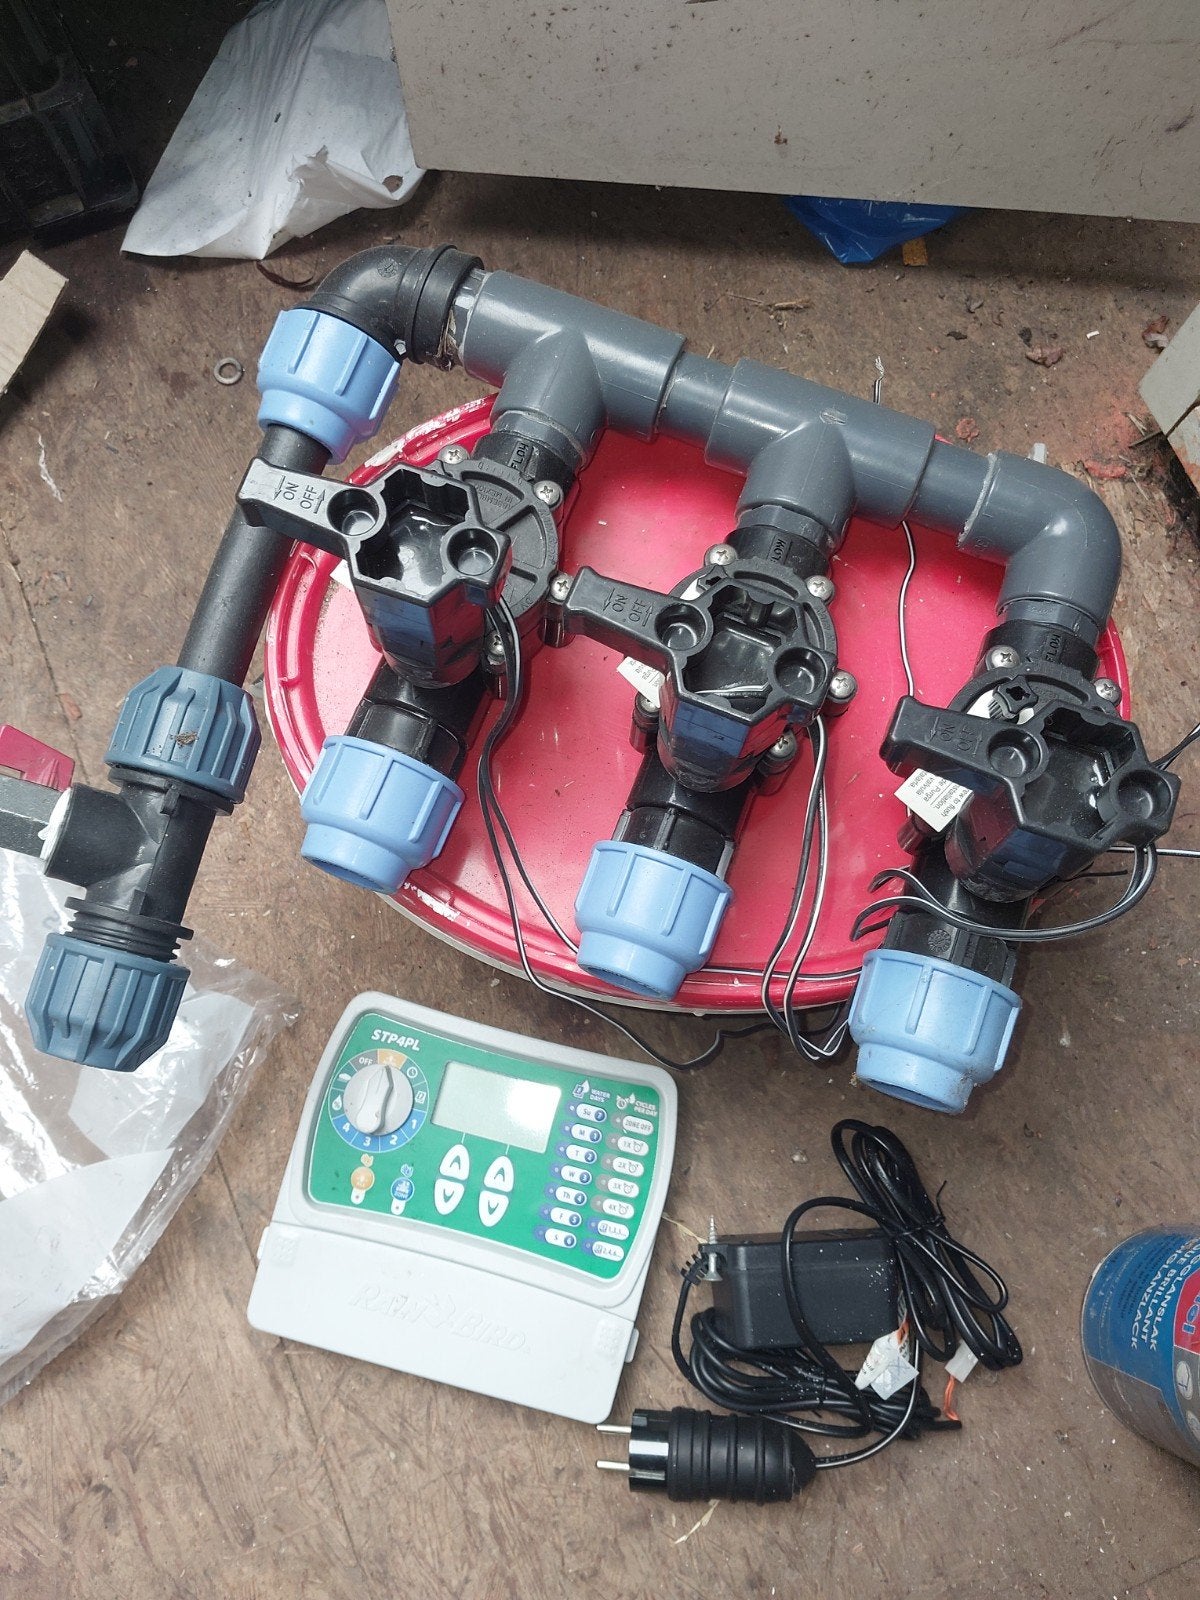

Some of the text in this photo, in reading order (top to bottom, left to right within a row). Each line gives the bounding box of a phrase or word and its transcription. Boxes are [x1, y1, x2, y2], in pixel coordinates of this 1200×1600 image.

[511, 442, 529, 469] FLOW
[282, 481, 299, 500] ON
[300, 485, 317, 509] OFF
[771, 538, 786, 563] LOW
[612, 594, 628, 612] ON
[629, 598, 646, 622] OFF
[940, 723, 955, 742] ON
[958, 724, 975, 751] OFF
[371, 1029, 420, 1051] STP4PL
[358, 1057, 374, 1066] OFF
[590, 1088, 611, 1099] WATER
[583, 1108, 591, 1116] Su
[342, 1122, 350, 1132] 4
[411, 1119, 417, 1130] 1
[640, 1123, 652, 1131] OFF
[362, 1136, 371, 1147] 3
[389, 1134, 398, 1145] 2
[563, 1191, 571, 1199] Th
[1141, 1269, 1177, 1344] BRILLANT
